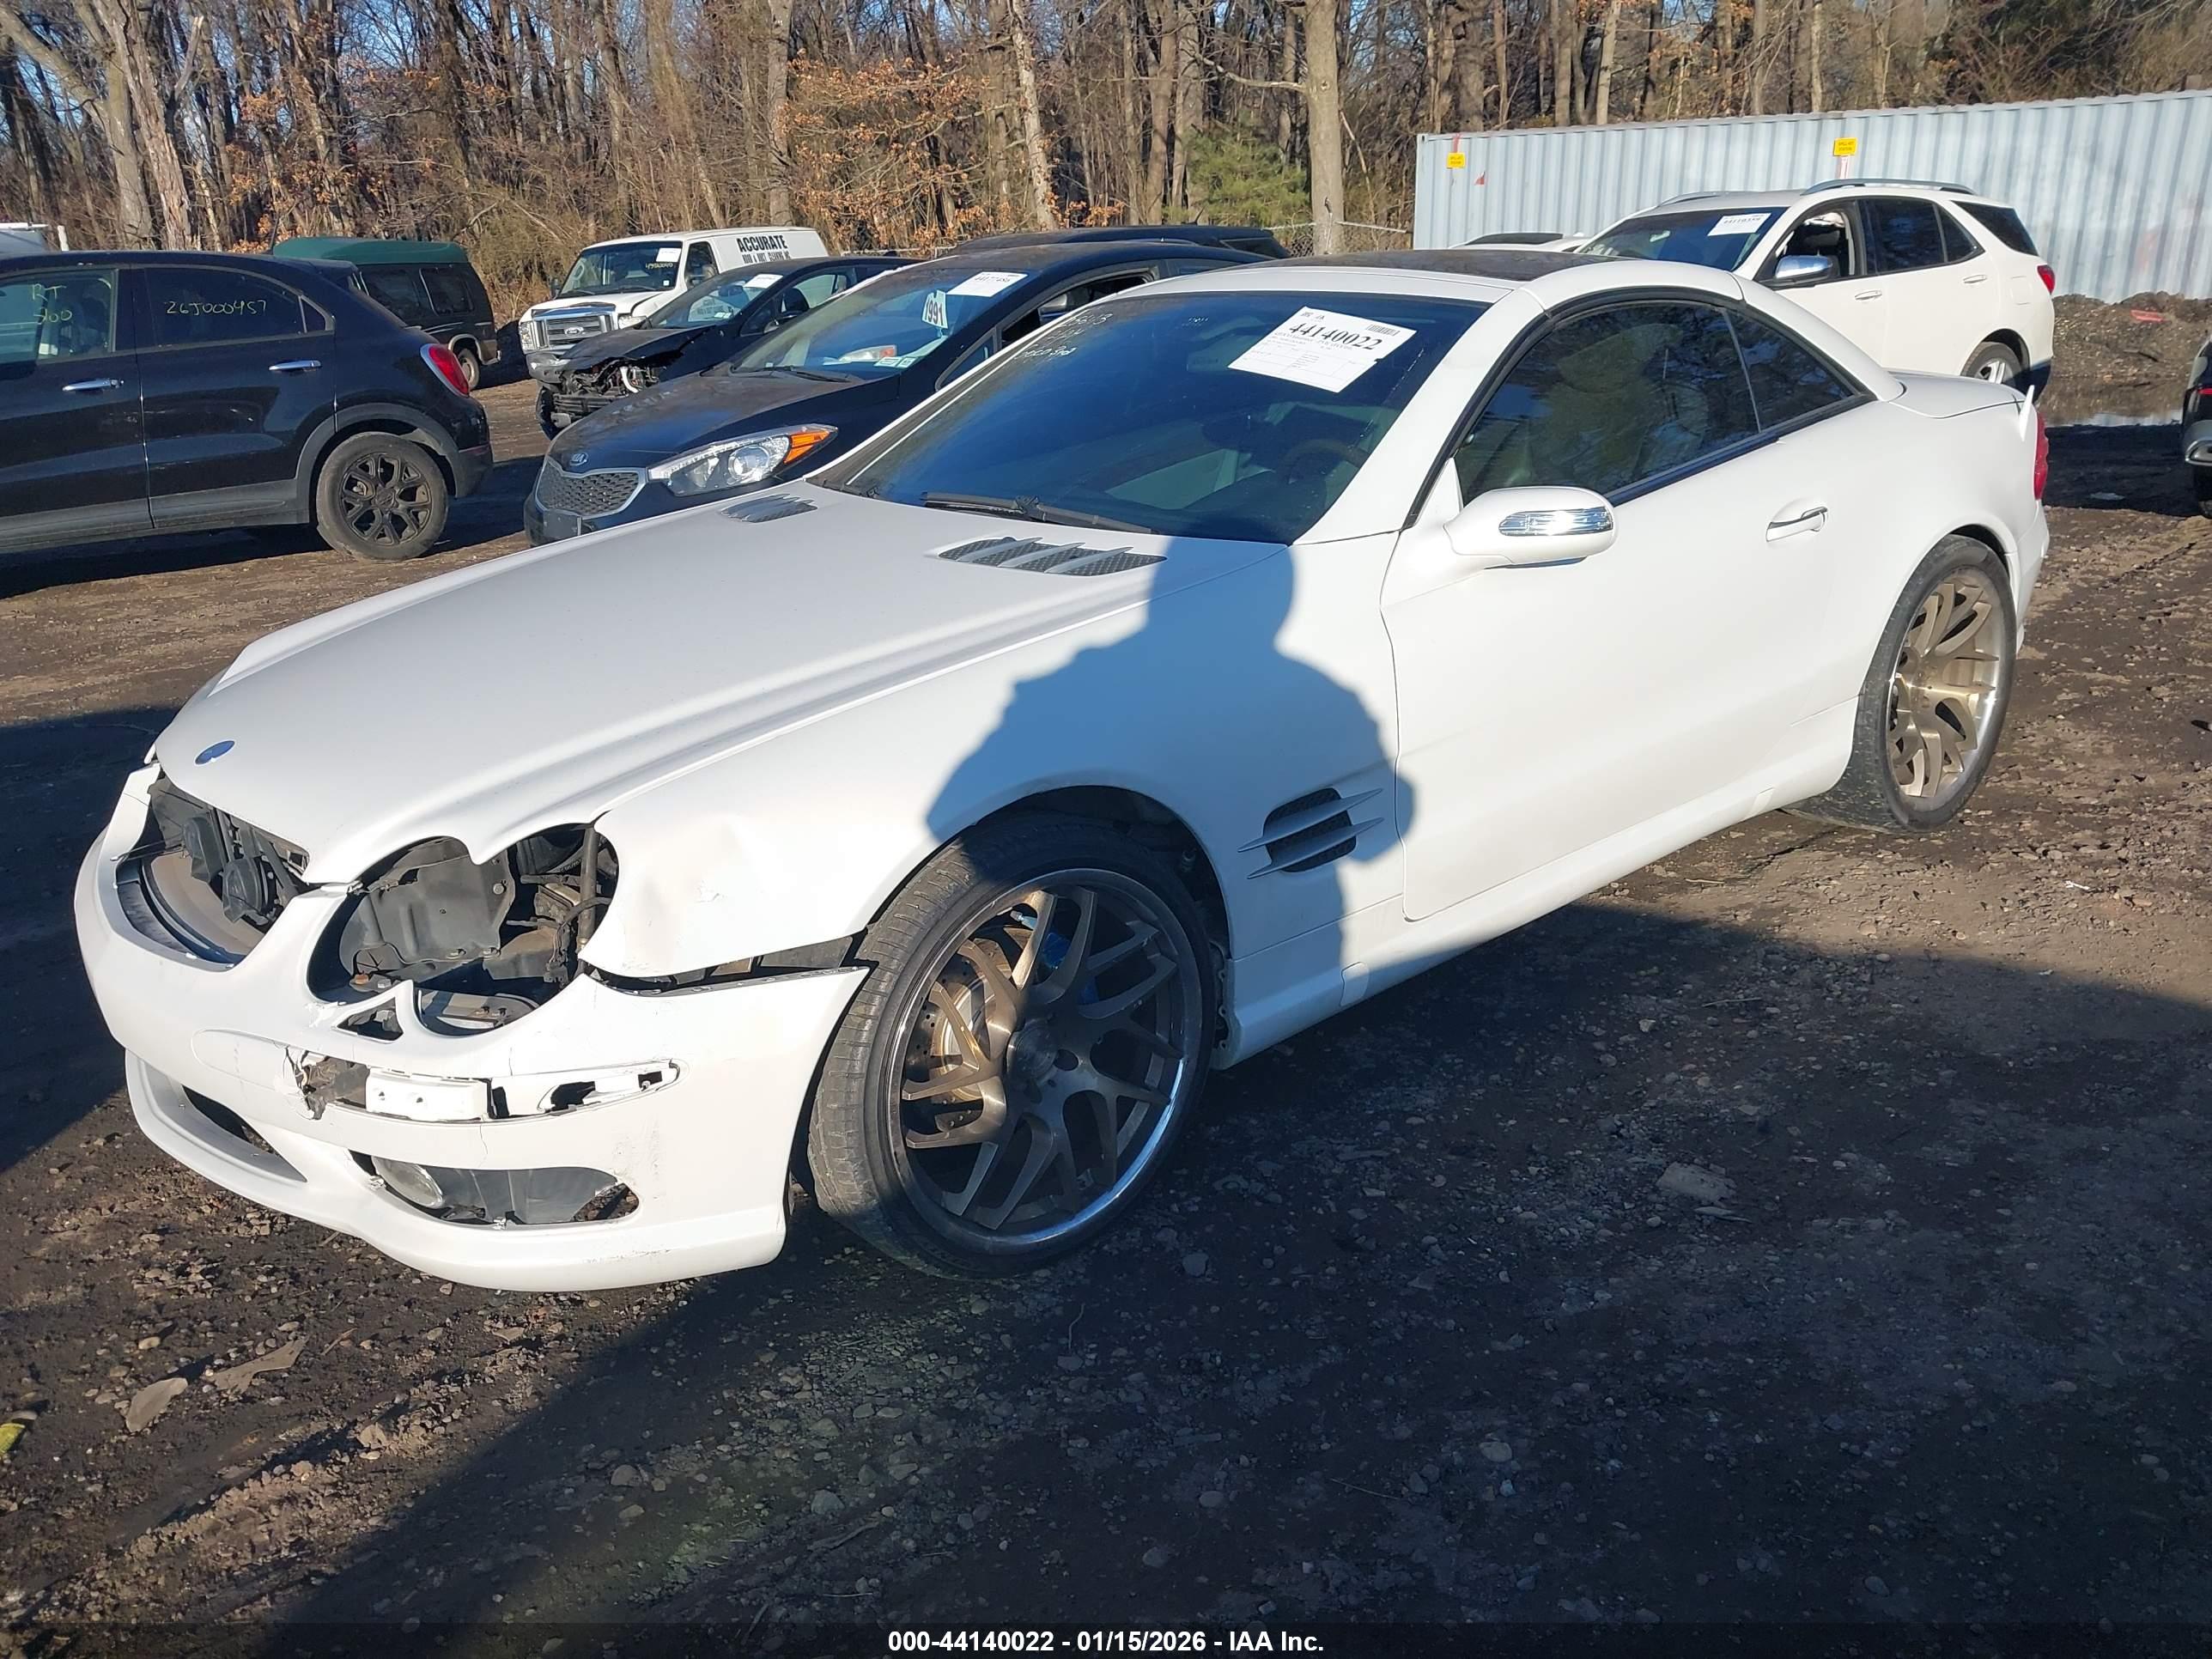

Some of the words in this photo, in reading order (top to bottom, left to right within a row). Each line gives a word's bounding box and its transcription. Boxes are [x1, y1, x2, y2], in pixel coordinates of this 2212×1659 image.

[736, 235, 788, 252] ACCURATE
[924, 300, 945, 326] 1991
[1289, 322, 1383, 350] 44140022
